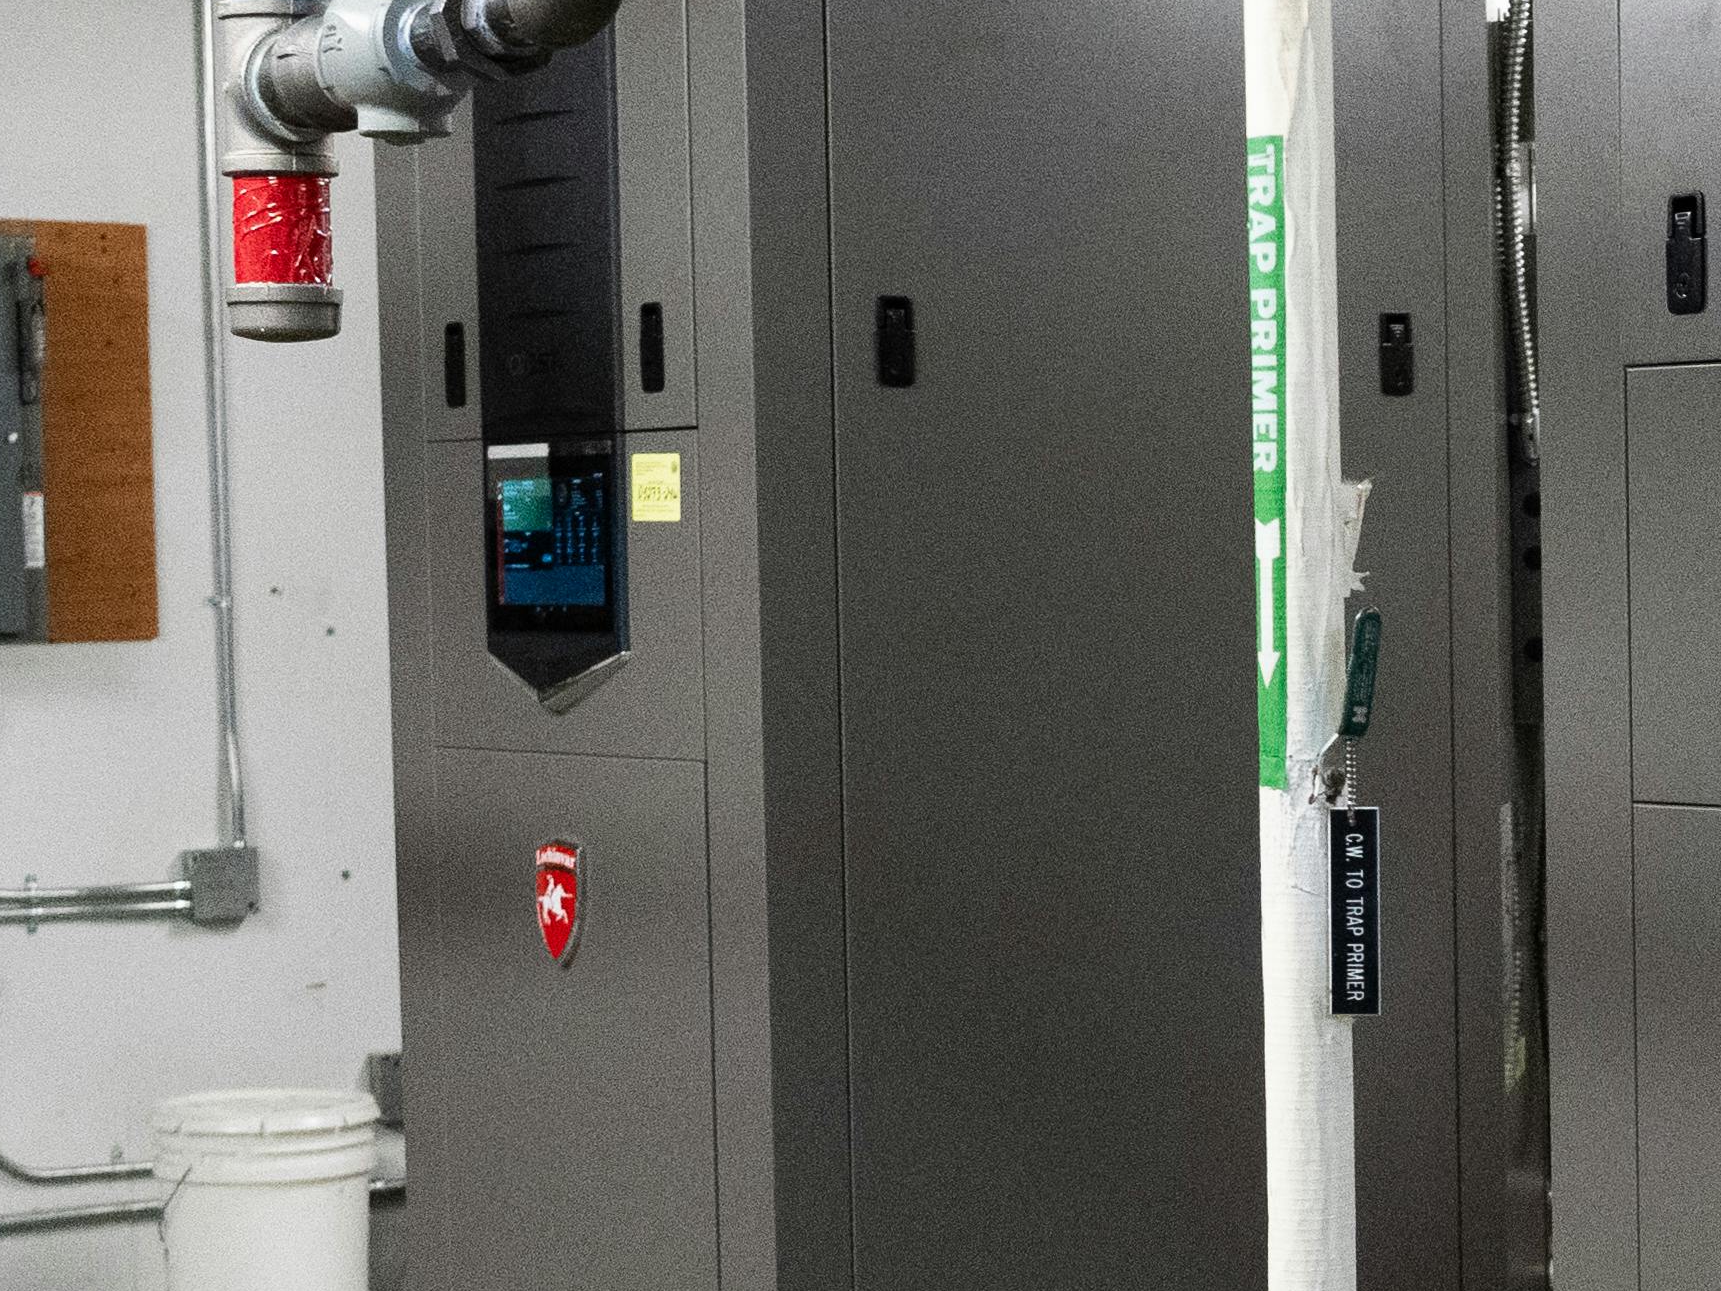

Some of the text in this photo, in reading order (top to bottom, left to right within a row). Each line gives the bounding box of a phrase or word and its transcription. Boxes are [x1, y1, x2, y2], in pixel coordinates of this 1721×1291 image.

[1247, 143, 1279, 474] TRAP PRIMER
[1345, 833, 1365, 1002] C.W. TO TRAP PRIMER
